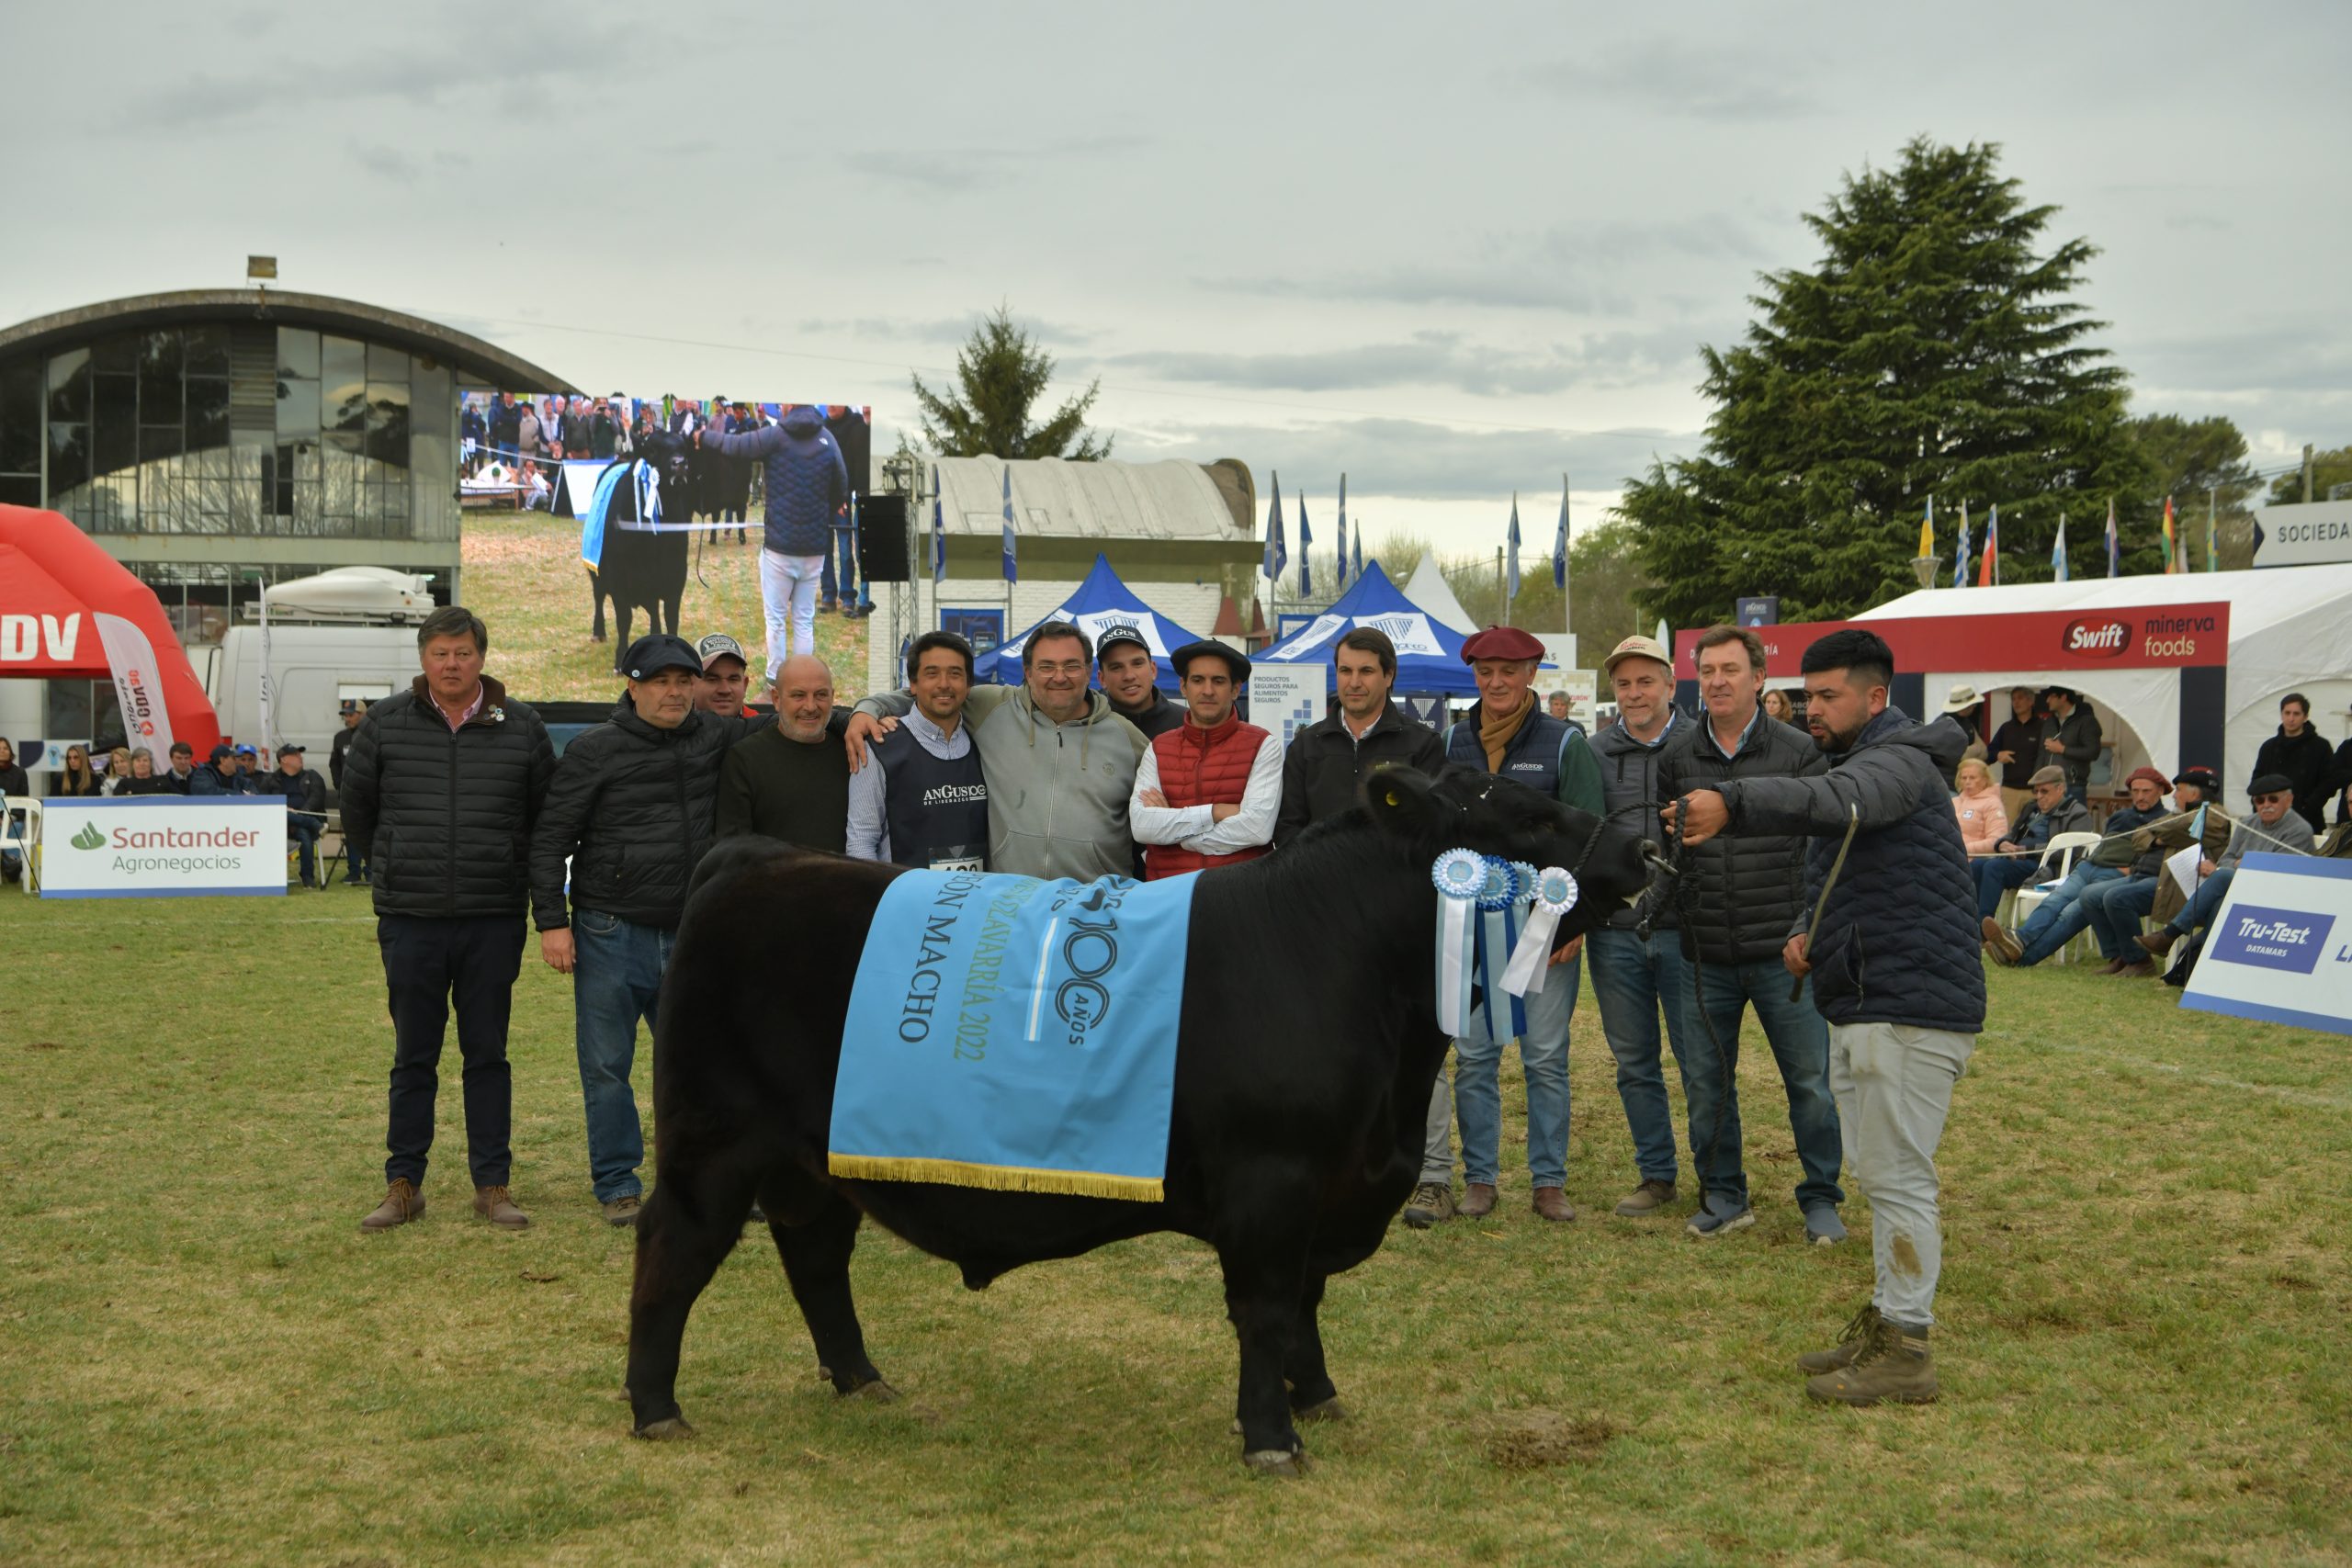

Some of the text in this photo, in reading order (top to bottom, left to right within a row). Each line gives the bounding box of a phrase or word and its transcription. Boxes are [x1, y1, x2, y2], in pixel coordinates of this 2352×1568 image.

[2278, 522, 2352, 544] SOCIEDA
[2145, 615, 2215, 634] minerva
[2069, 623, 2124, 649] Swift
[2144, 635, 2196, 657] foods
[112, 827, 260, 849] Santander
[111, 854, 242, 874] Agronegocios
[2238, 918, 2311, 945] Tru-Test
[2245, 943, 2288, 957] DATAMARS
[899, 914, 958, 1043] MACHO
[1069, 992, 1091, 1045] AÑOS
[953, 1011, 991, 1062] 2022
